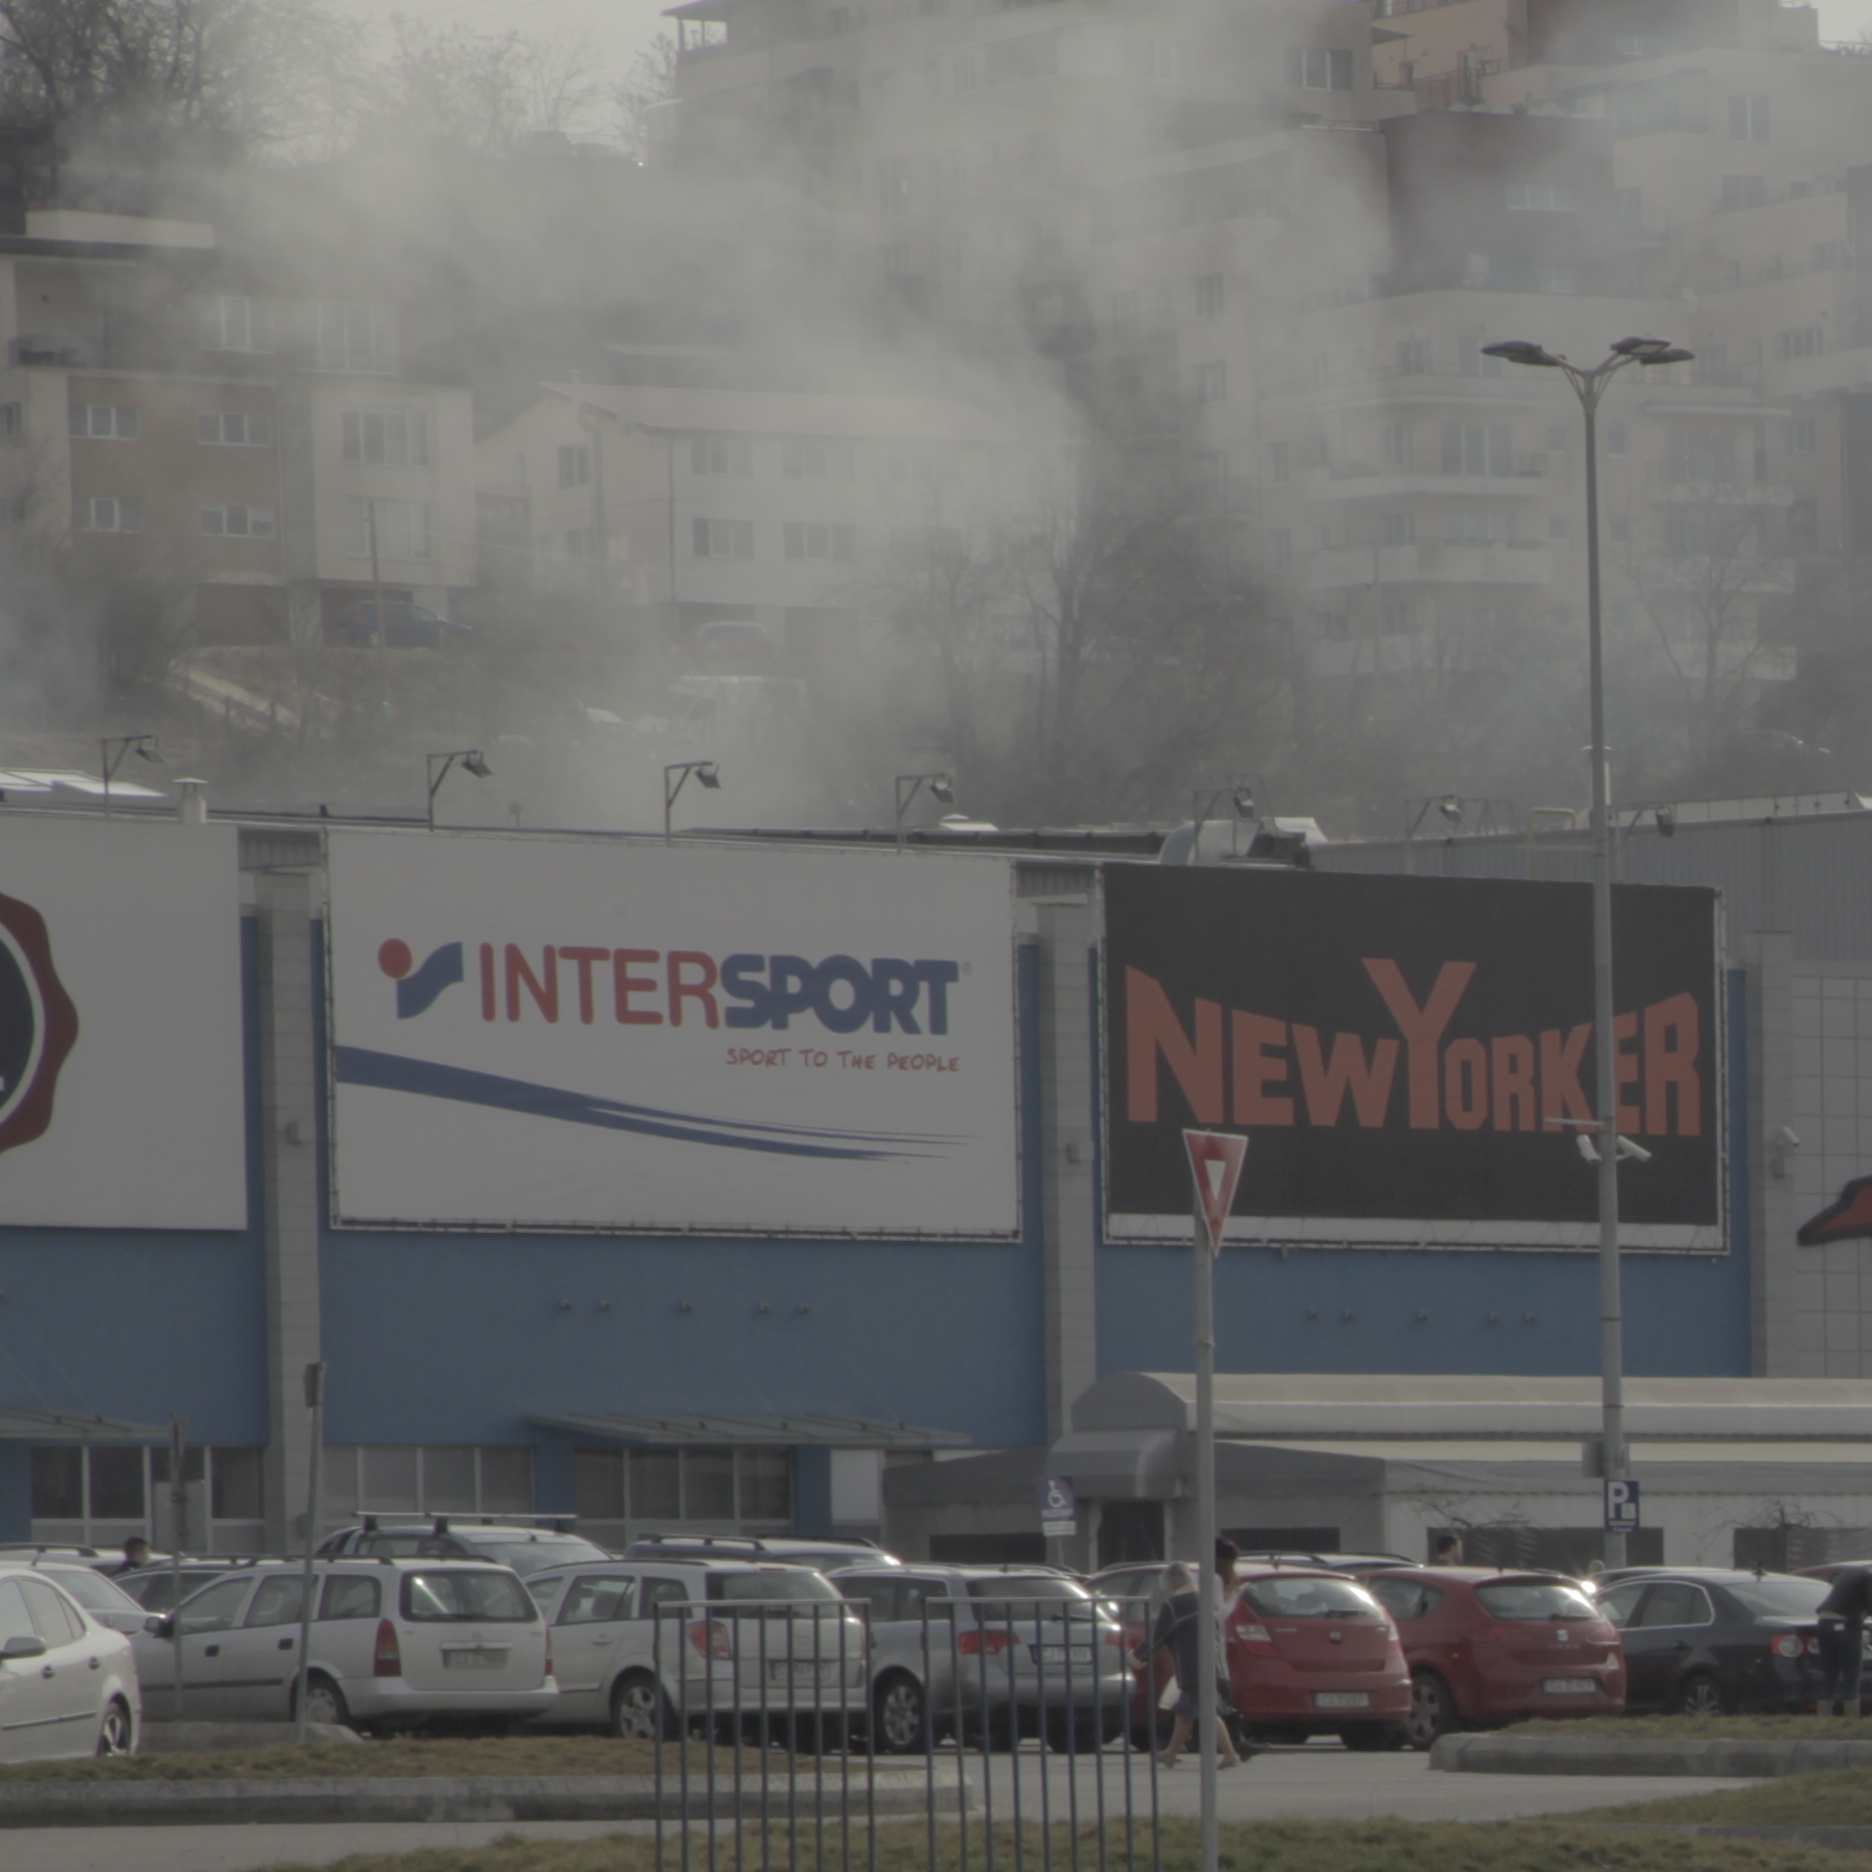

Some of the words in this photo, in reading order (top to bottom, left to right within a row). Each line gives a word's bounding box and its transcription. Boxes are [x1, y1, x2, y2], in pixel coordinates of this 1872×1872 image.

[480, 942, 959, 1035] INTERSPORT
[724, 1047, 792, 1068] SPORT
[799, 1049, 828, 1068] TO
[837, 1050, 876, 1069] THE
[887, 1052, 960, 1072] PEOPLE
[1608, 1481, 1629, 1518] P
